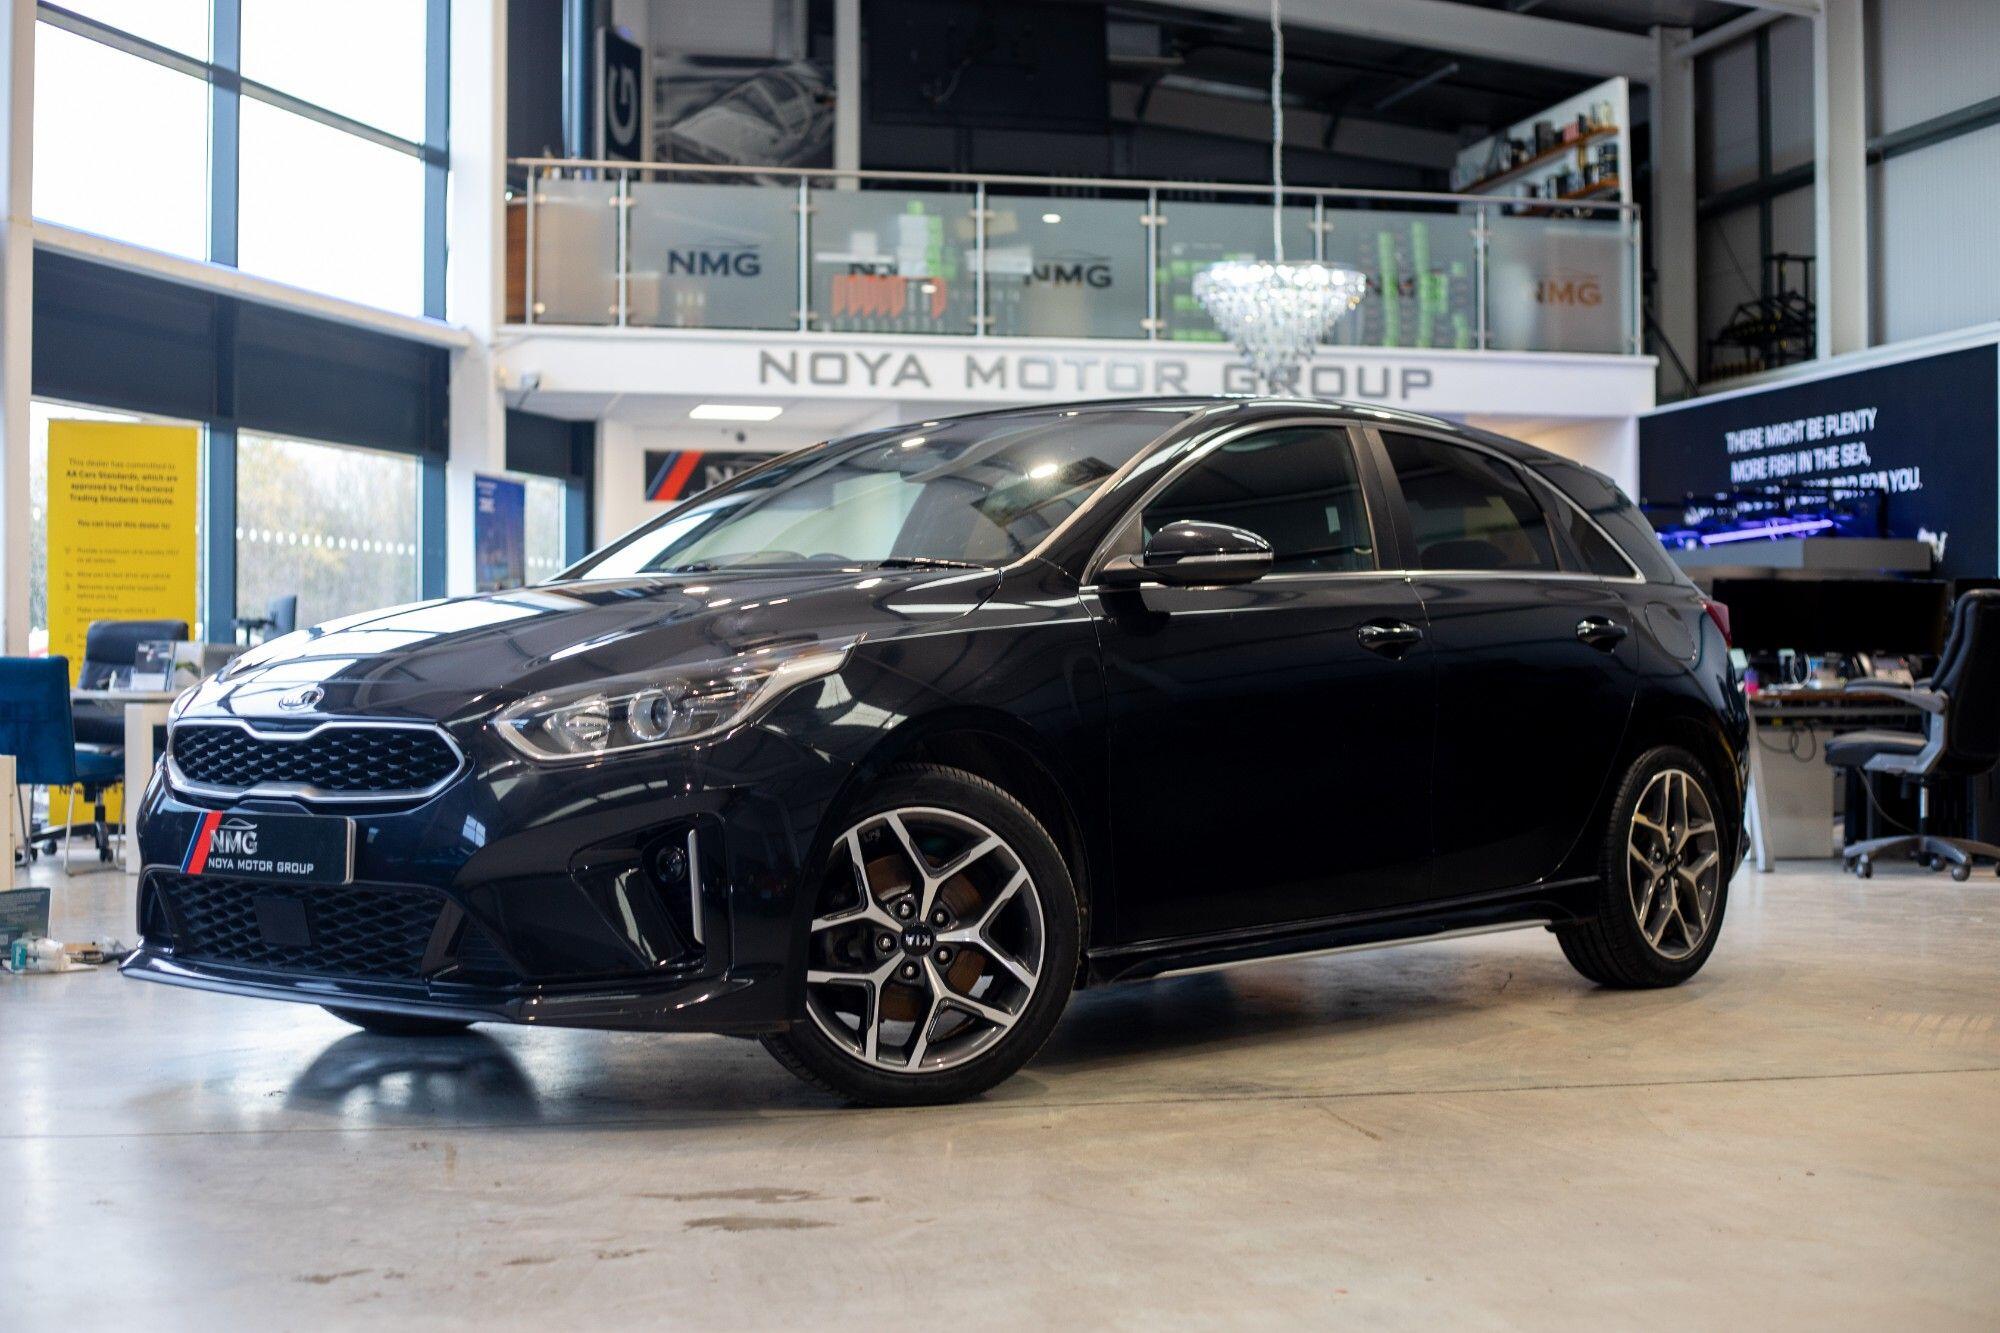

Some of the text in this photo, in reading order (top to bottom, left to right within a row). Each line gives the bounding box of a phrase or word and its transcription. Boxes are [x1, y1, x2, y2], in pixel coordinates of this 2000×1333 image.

[667, 250, 762, 277] NMG
[759, 349, 1433, 400] NOYA MOTOR GROUP
[1724, 406, 1878, 454] THERE MIGHT BE PLENTY
[66, 470, 77, 478] AA
[1730, 441, 1872, 484] MORE FISH IN THE SEA,
[1889, 466, 1923, 493] YOU.
[209, 829, 258, 855] NMG
[208, 857, 314, 875] NOYA MOTOR GROUP
[905, 934, 931, 946] KIA
